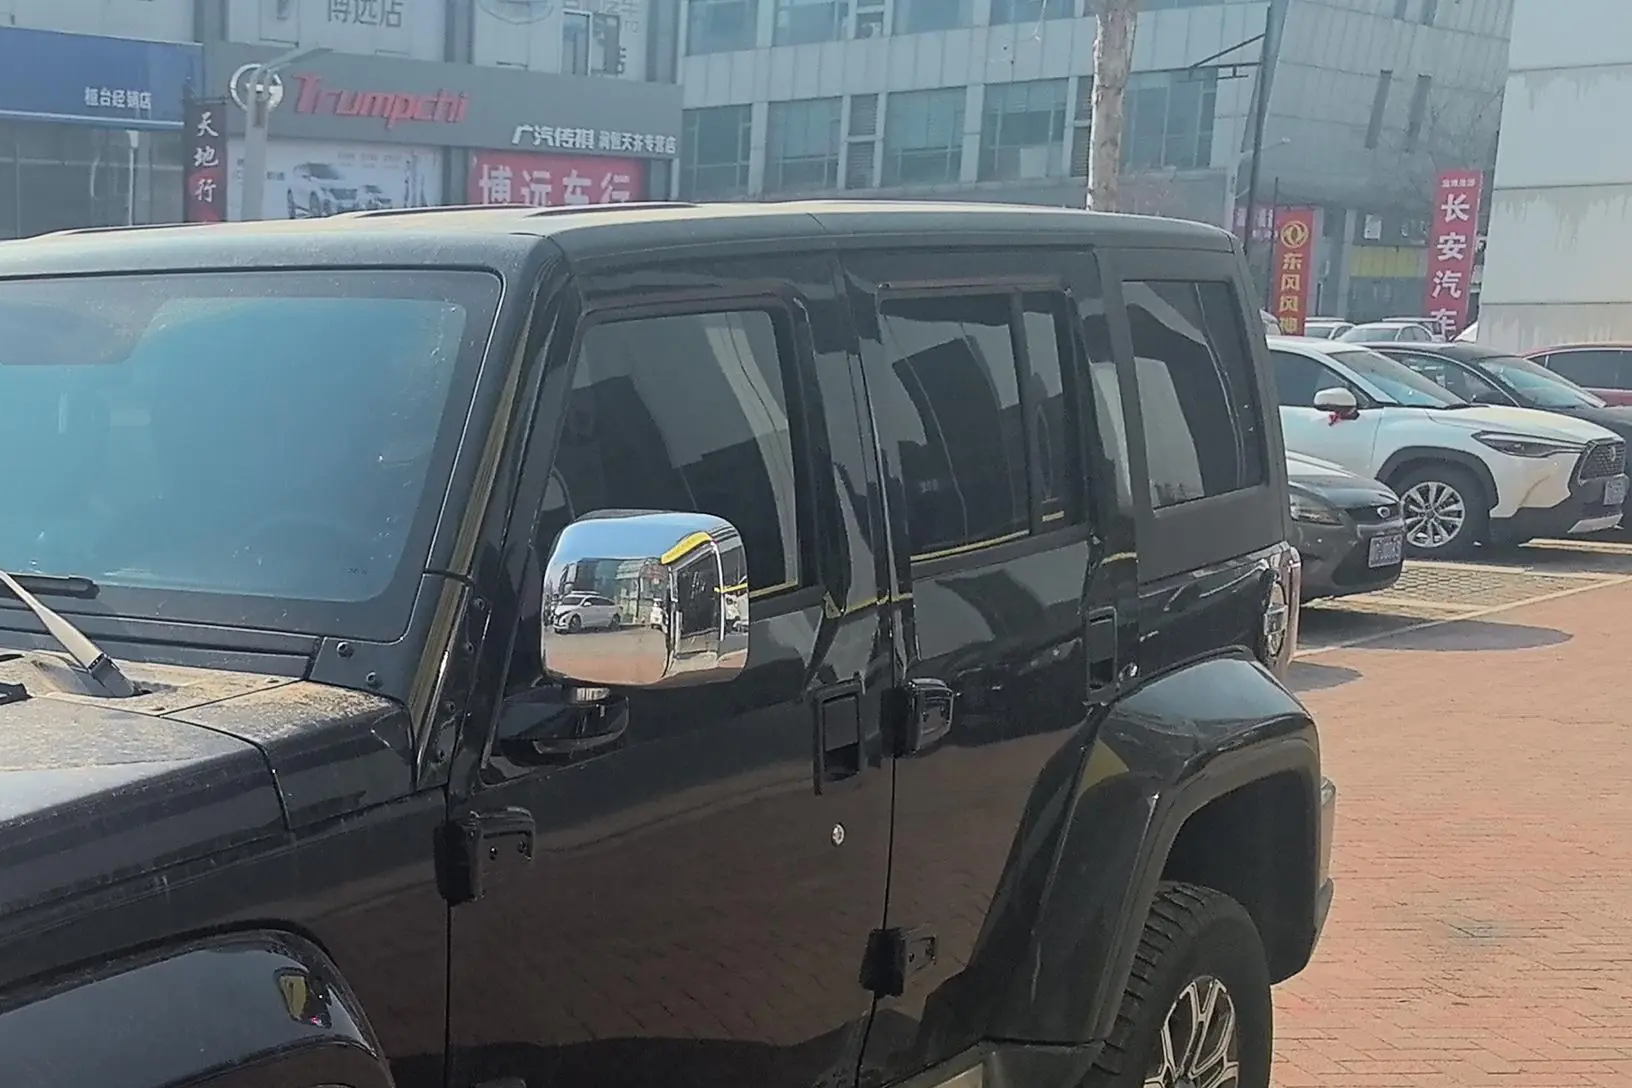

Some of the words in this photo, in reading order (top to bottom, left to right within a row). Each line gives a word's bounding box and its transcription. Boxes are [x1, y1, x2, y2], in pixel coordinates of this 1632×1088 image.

[292, 72, 467, 130] Trumpchi
[193, 111, 219, 203] 天地行
[511, 125, 594, 149] 广汽传祺
[478, 162, 631, 206] 博远车行
[1430, 194, 1471, 340] 长安汽车
